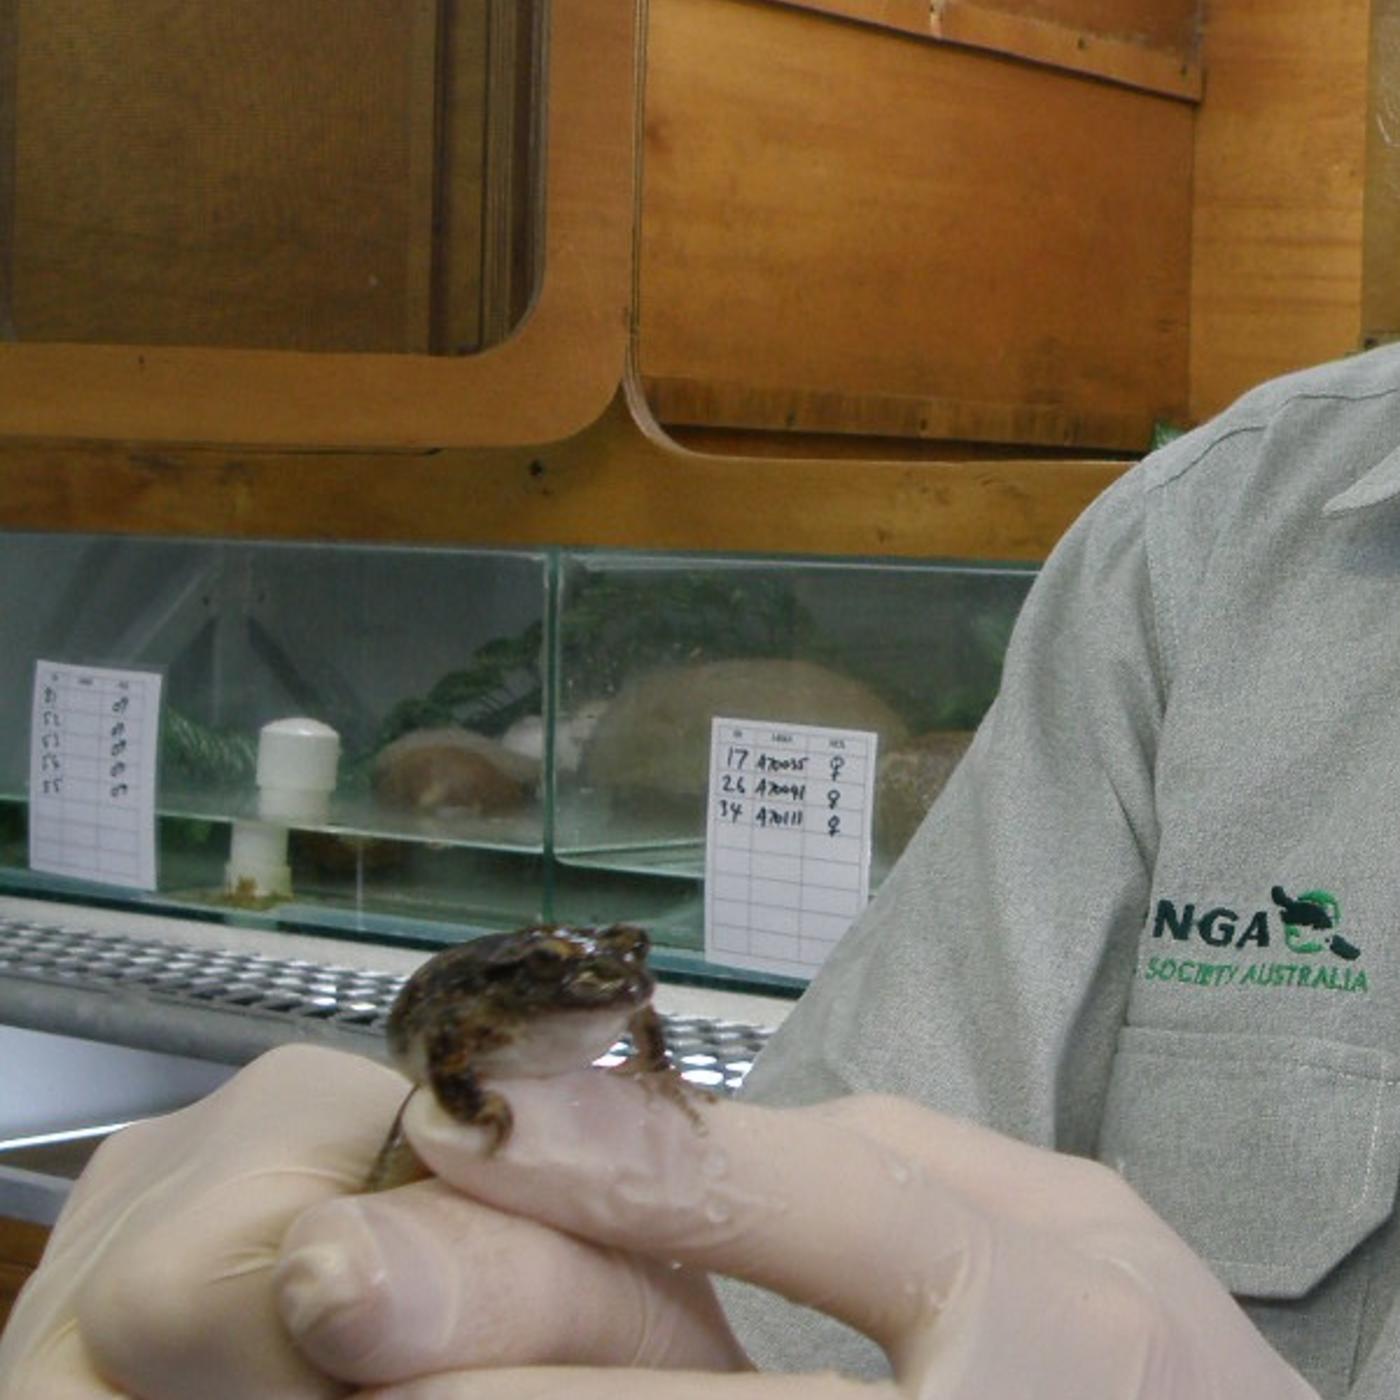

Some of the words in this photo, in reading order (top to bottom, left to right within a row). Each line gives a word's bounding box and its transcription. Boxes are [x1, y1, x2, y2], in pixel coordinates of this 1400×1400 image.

[727, 747, 749, 770] 17
[721, 774, 746, 794] 26
[719, 799, 743, 823] 34
[1152, 899, 1271, 949] NGA
[1145, 956, 1239, 987] SOCIETY
[1239, 962, 1369, 993] AUSTRALIA
